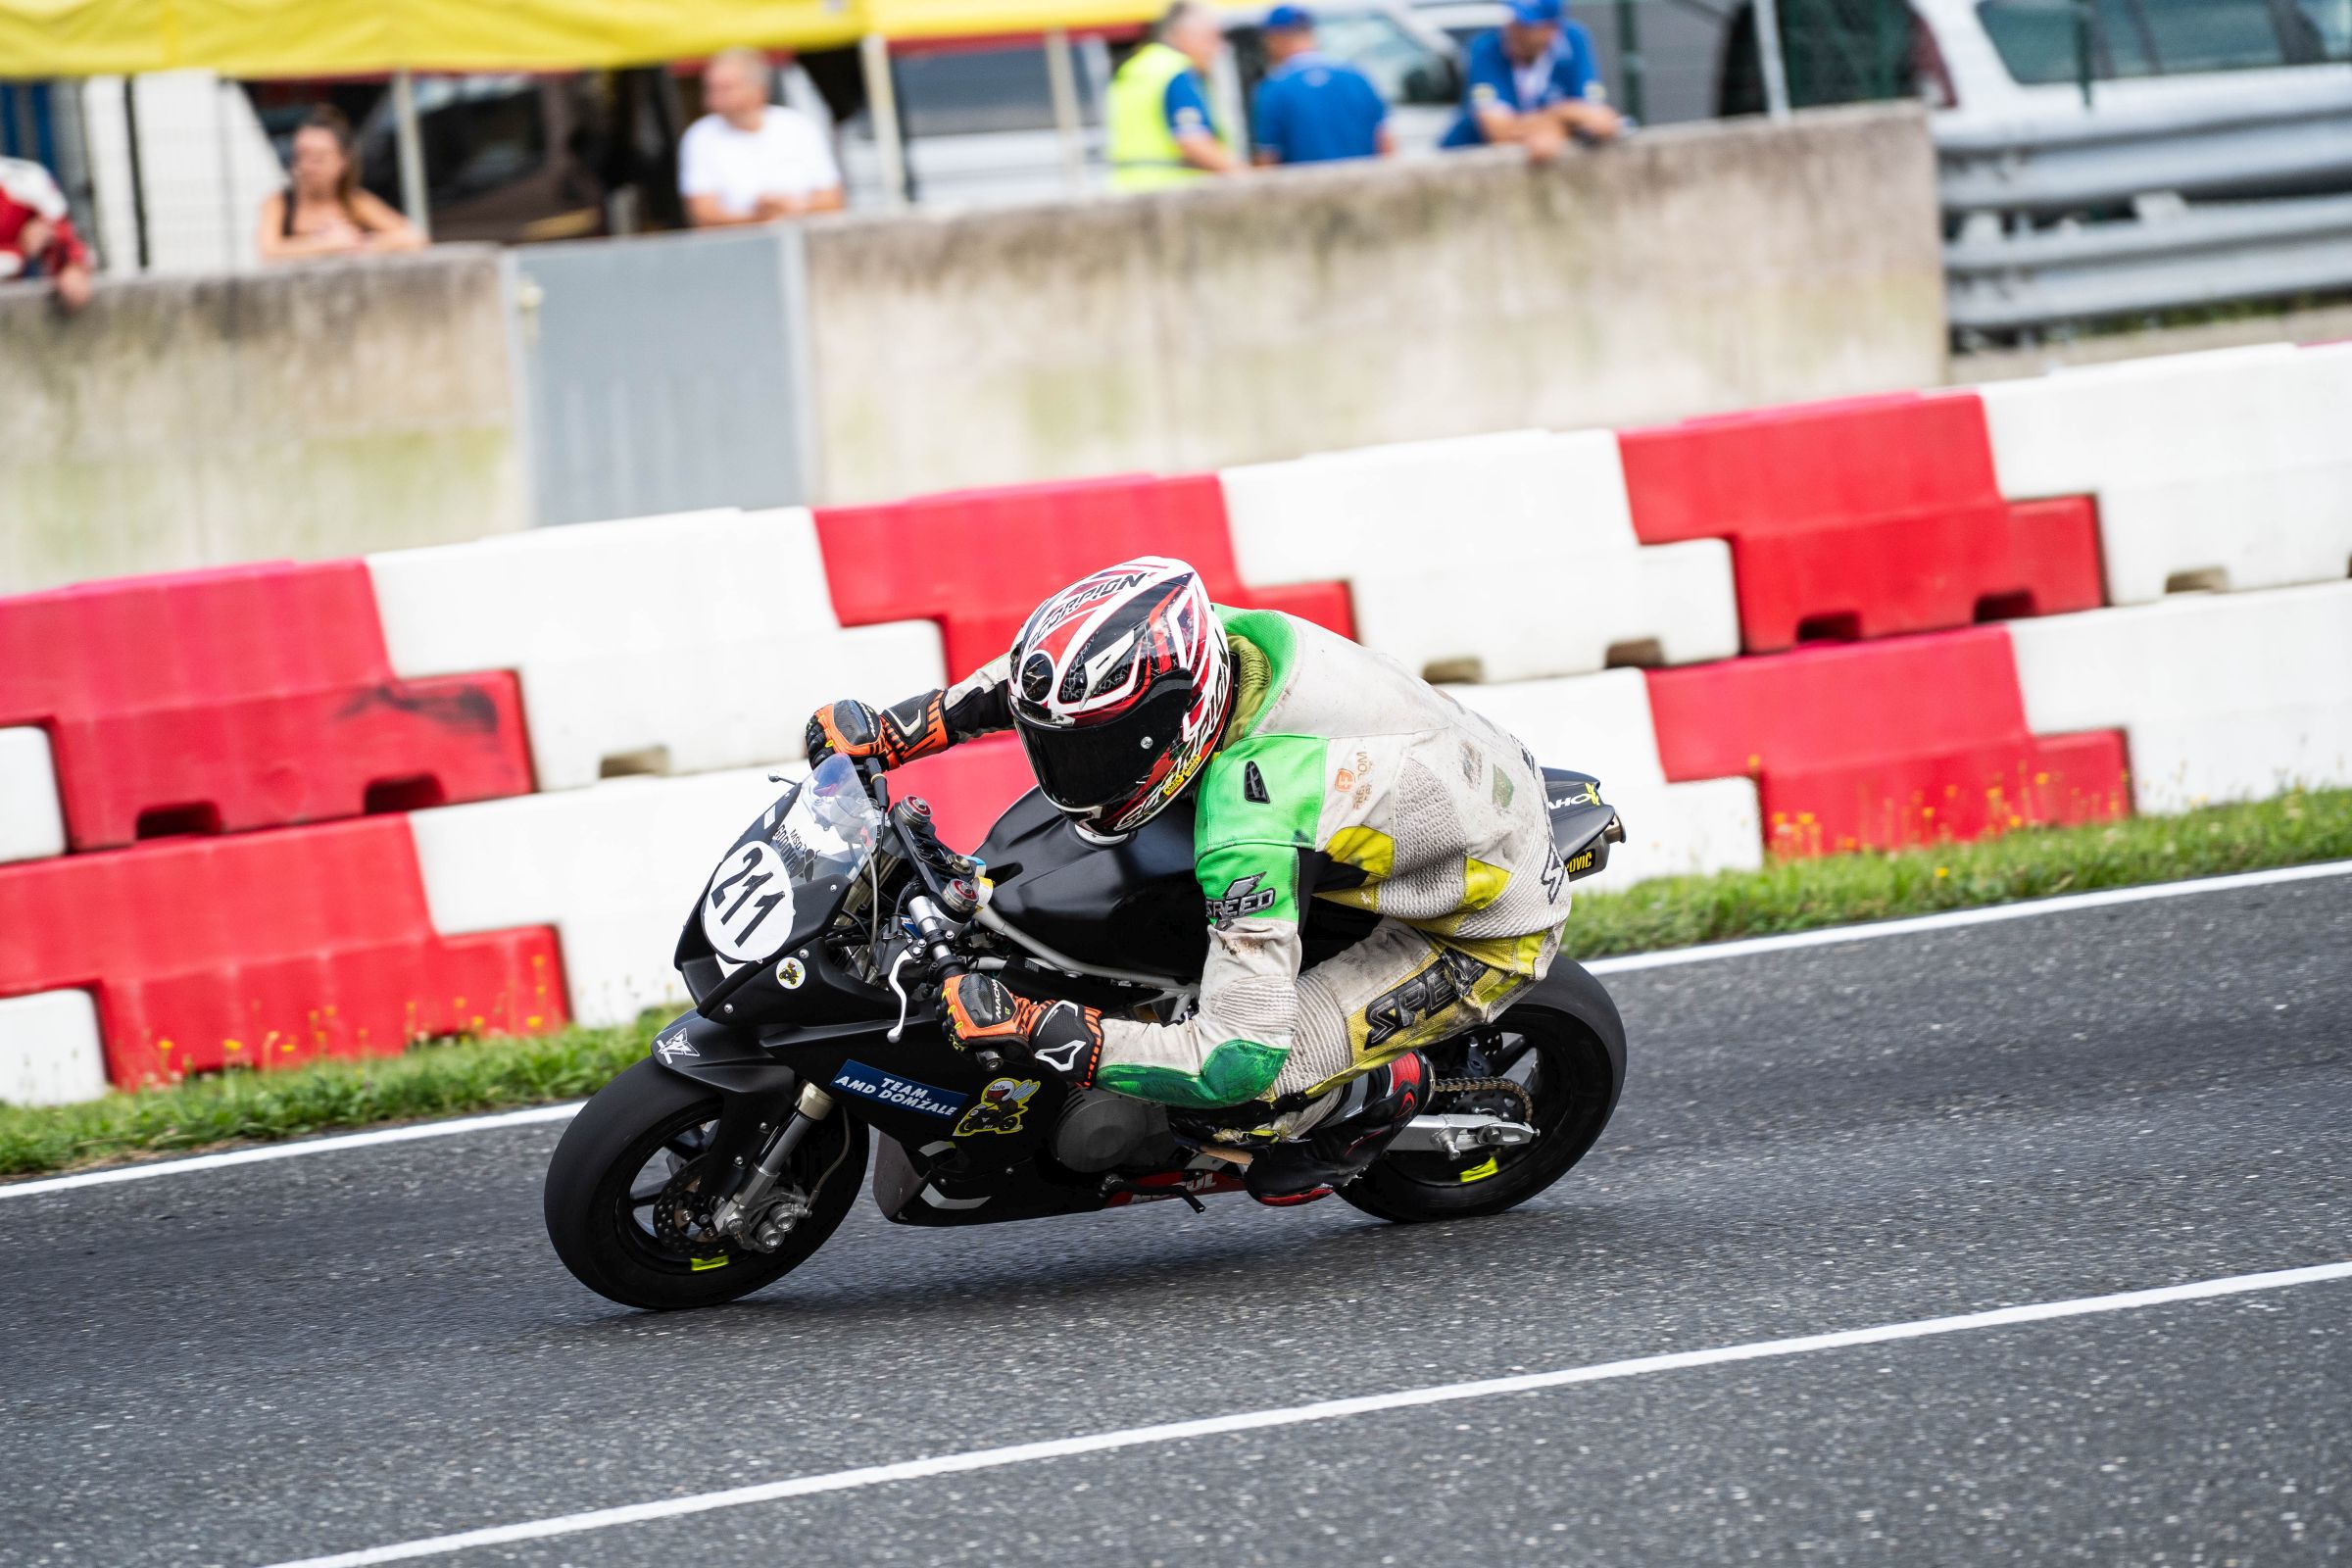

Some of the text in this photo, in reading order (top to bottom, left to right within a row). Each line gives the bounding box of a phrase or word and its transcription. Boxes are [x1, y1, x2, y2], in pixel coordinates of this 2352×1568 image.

[1027, 572, 1148, 649] SCORPION
[1567, 851, 1592, 873] OVIČ
[710, 847, 786, 949] 211
[834, 1075, 958, 1116] AMD DOMŽALE
[881, 1077, 928, 1099] TEAM
